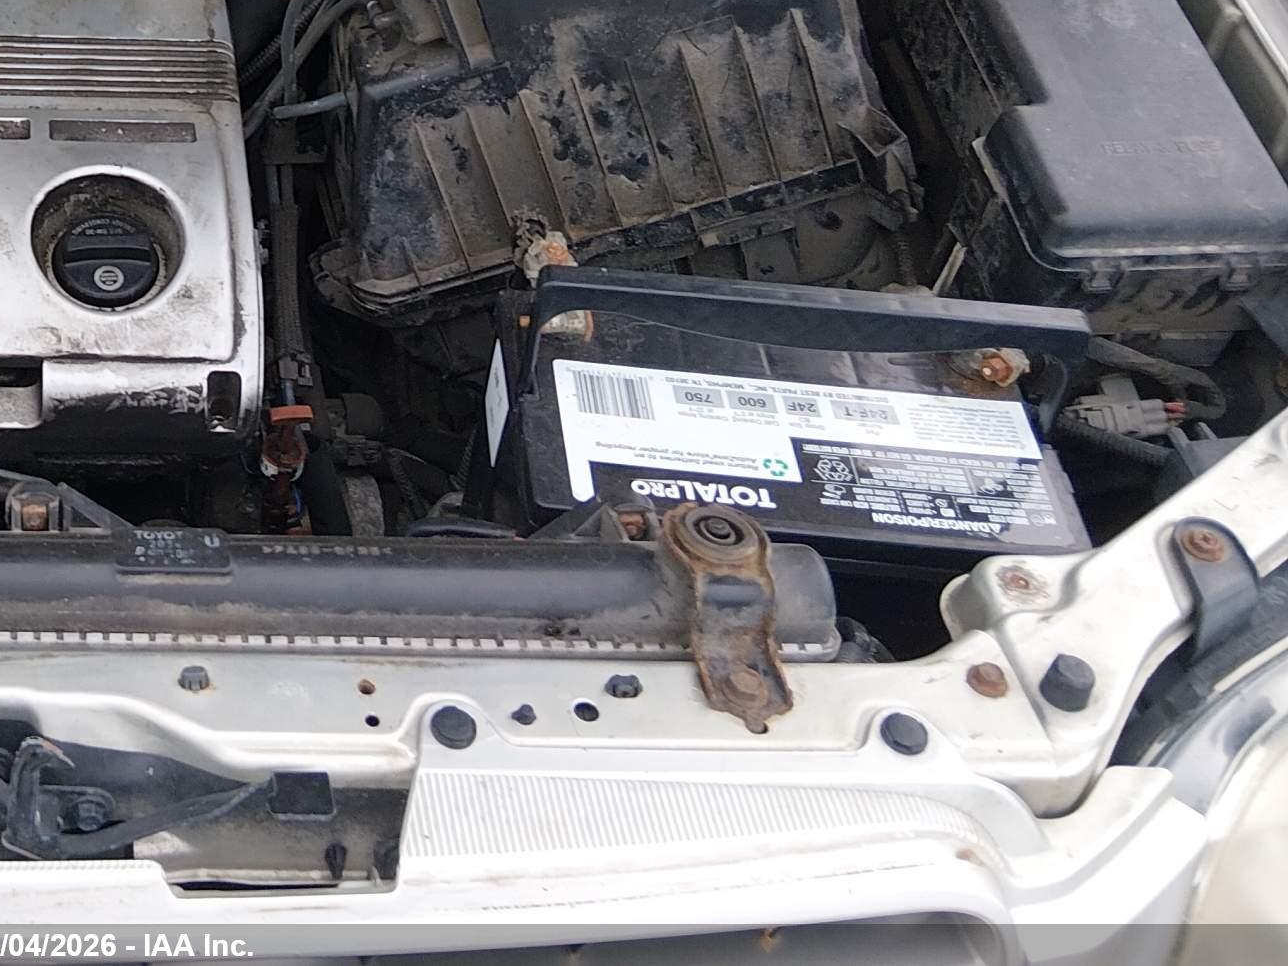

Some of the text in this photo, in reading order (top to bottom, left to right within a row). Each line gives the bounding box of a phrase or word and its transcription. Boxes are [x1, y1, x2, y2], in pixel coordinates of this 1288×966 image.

[684, 391, 714, 404] 750
[738, 396, 766, 409] 600
[787, 401, 817, 413] 24F
[630, 478, 777, 509] TOTALPRO
